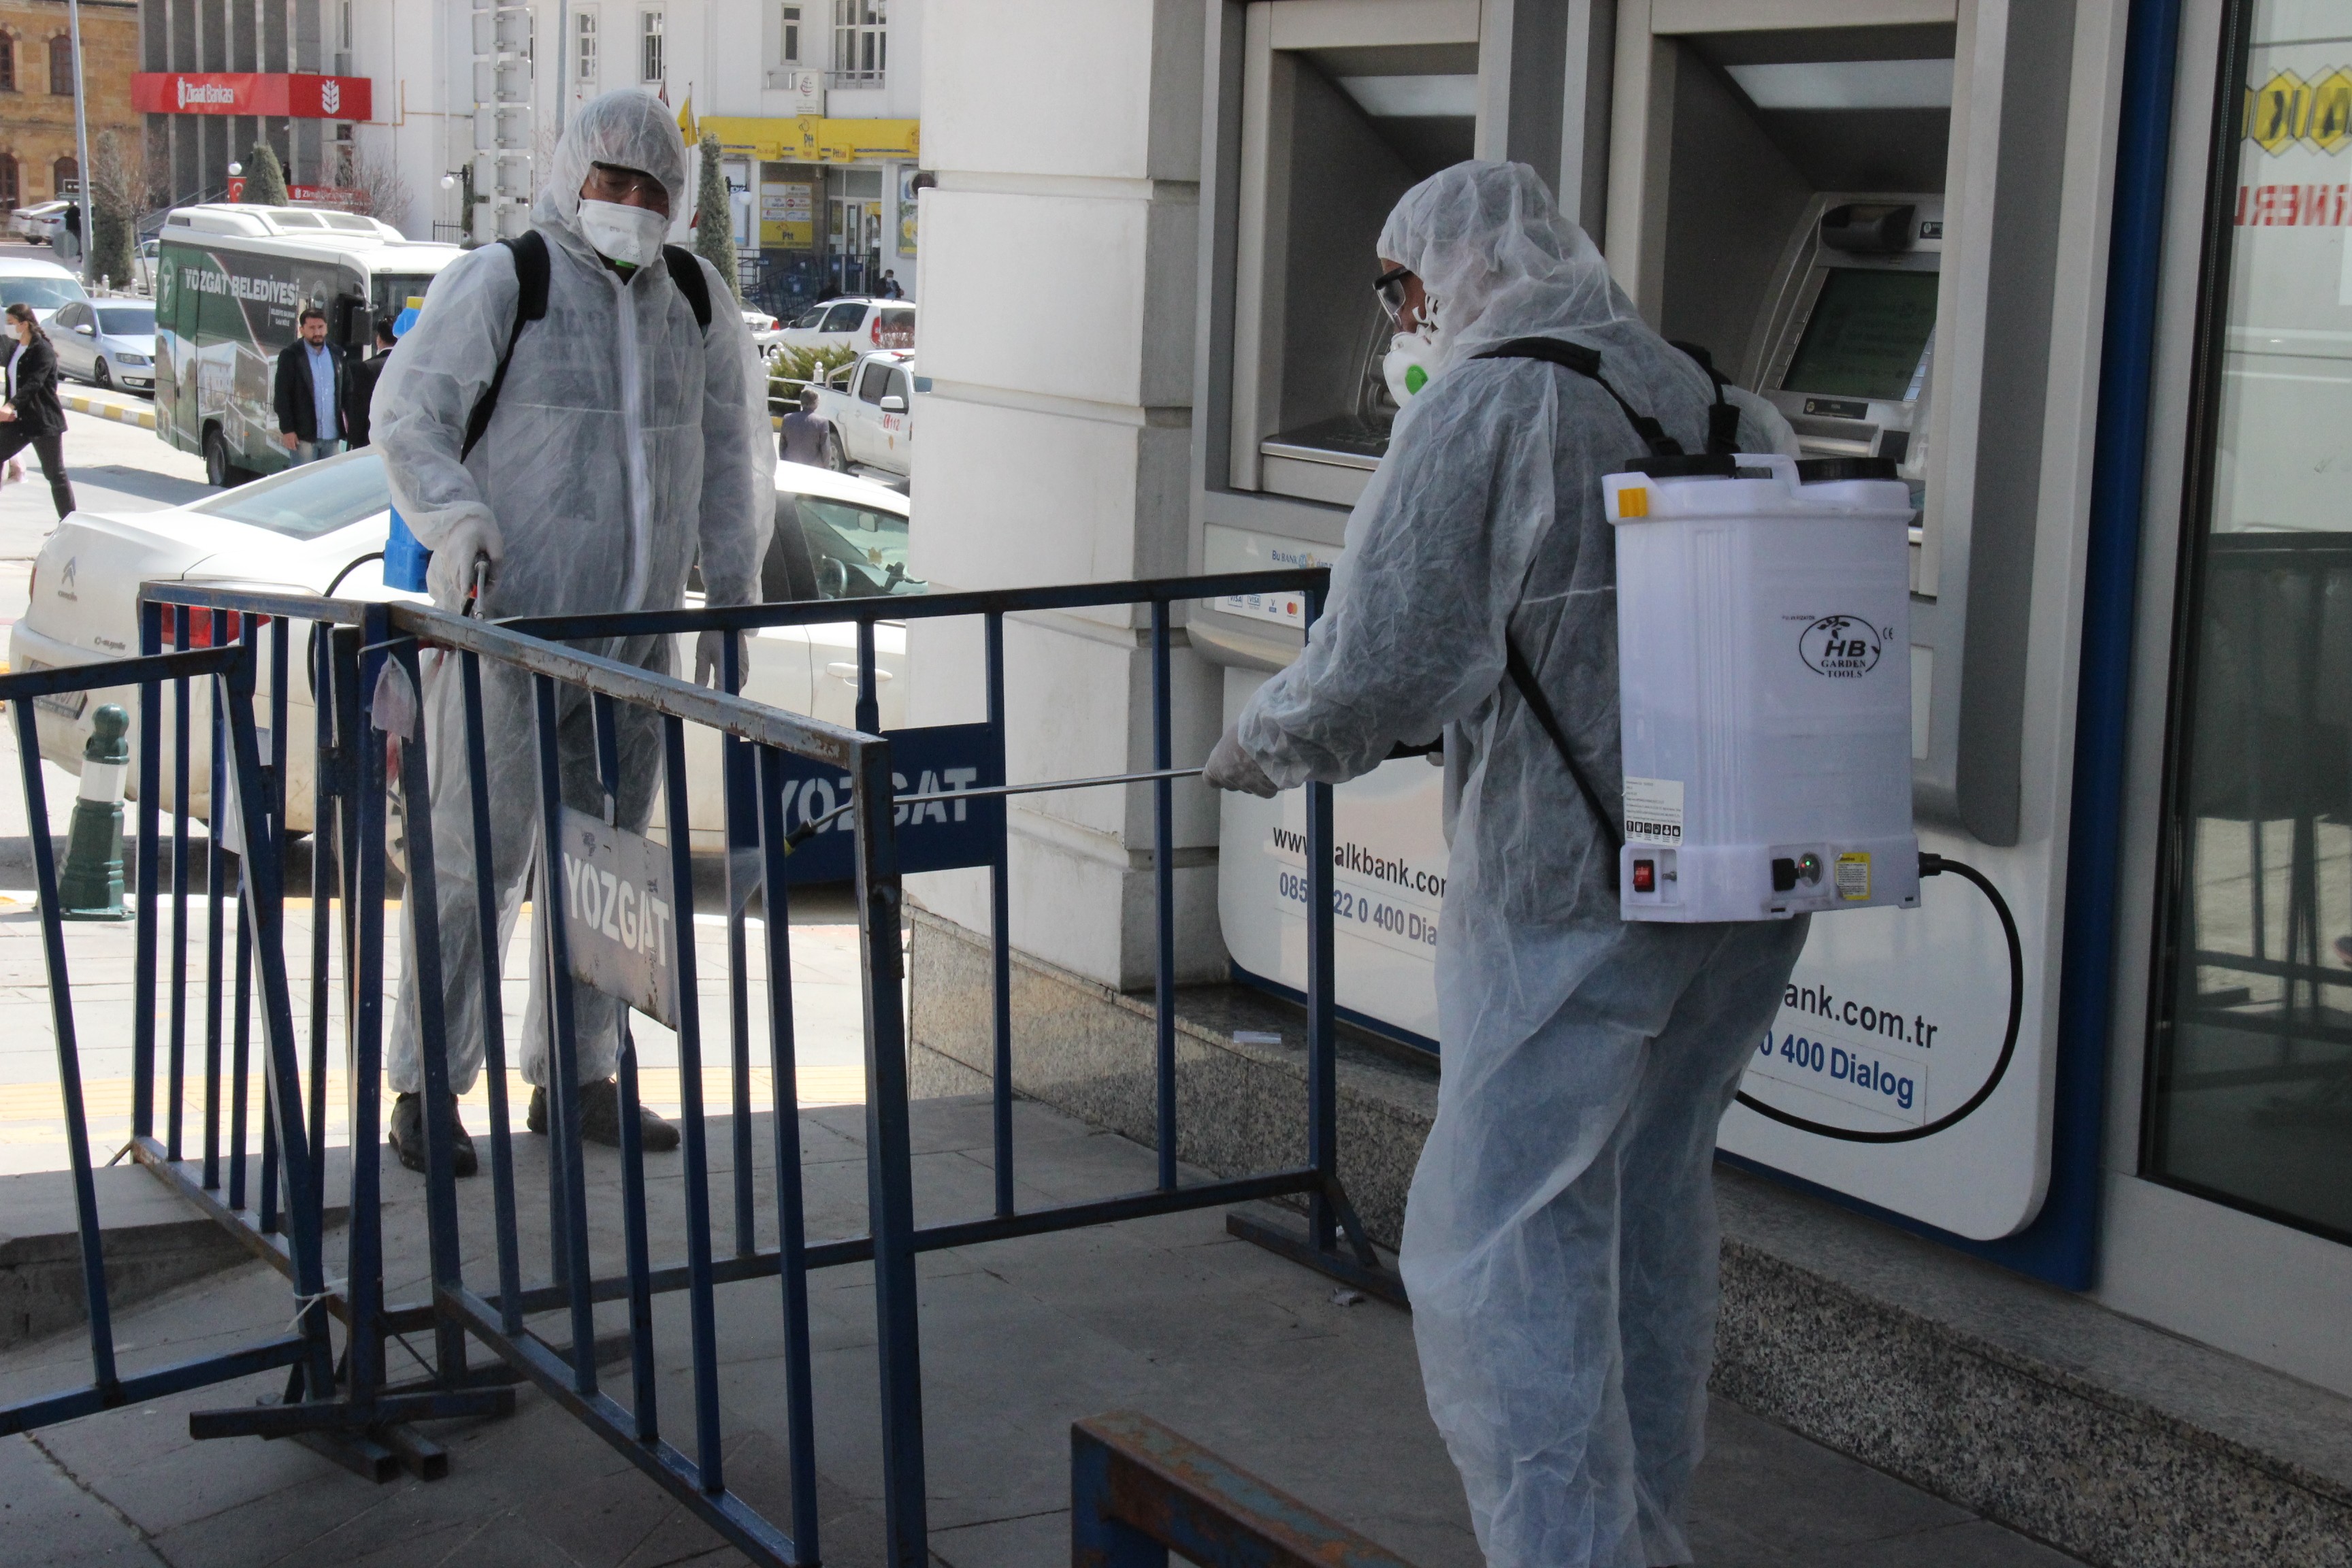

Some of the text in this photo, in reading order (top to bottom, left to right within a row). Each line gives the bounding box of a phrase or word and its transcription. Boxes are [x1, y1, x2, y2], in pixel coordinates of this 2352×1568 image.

[186, 83, 206, 103] Ziraat
[804, 133, 814, 148] Ptt
[184, 267, 300, 306] YOZGAT BELEDİYESİ
[1272, 550, 1280, 561] Bu
[1281, 553, 1298, 565] BANK
[1825, 640, 1867, 657] HB
[1820, 659, 1867, 668] GARDEN
[1826, 670, 1863, 679] TOOLS
[1273, 826, 1448, 898] wwalkbank.co
[564, 852, 670, 967] YOZGAT
[1279, 872, 1437, 947] 085 22 0 400 Dia
[1784, 983, 1938, 1049] ank.com.tr
[1780, 1033, 1825, 1073] 400
[1830, 1047, 1914, 1109] Dialog
